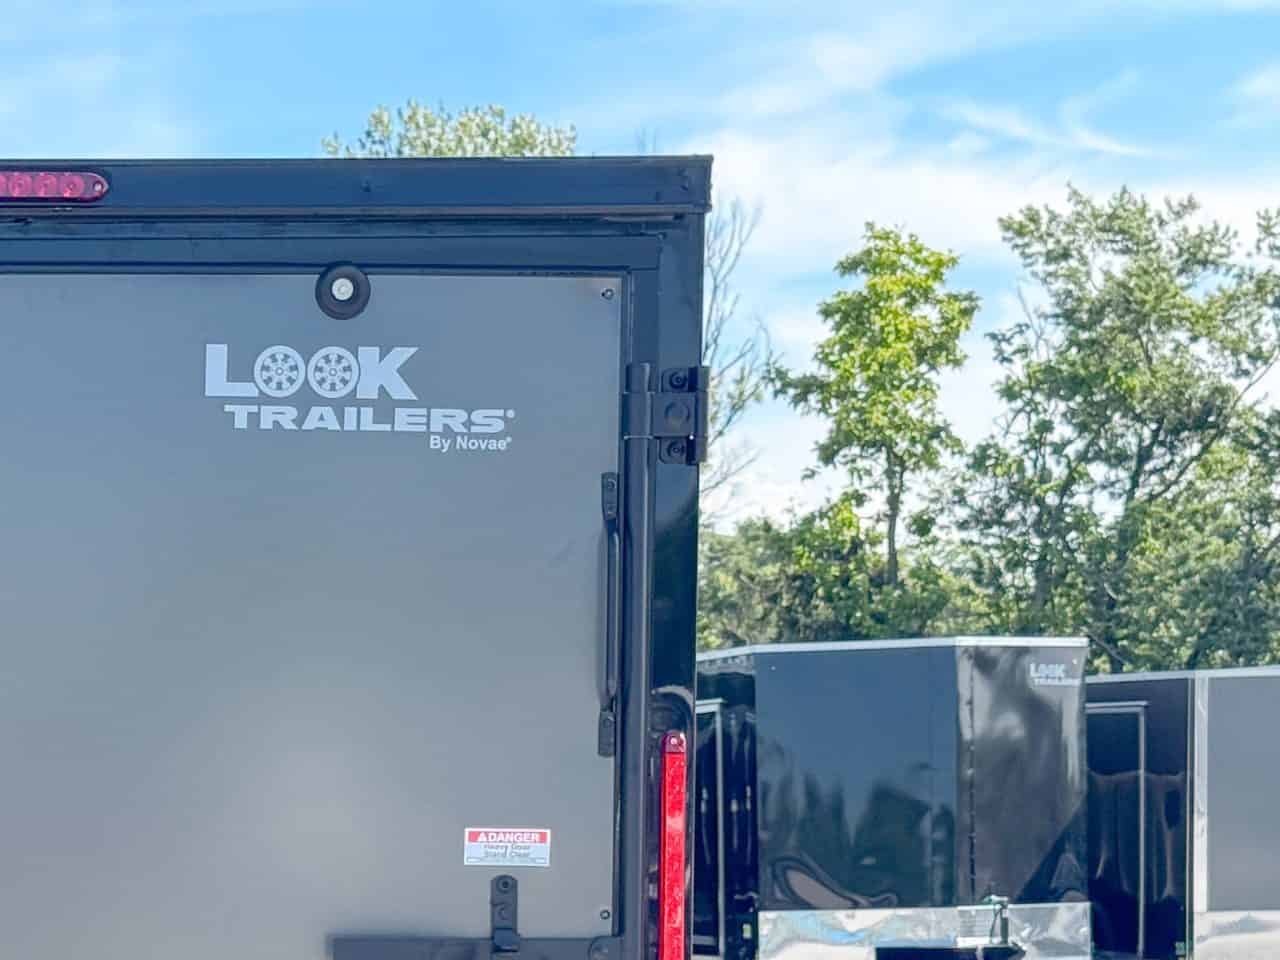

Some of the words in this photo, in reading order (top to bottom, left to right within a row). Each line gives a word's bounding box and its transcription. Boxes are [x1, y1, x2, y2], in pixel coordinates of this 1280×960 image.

[205, 344, 419, 400] LOOK
[224, 404, 505, 433] TRAILERS
[430, 434, 451, 453] By
[456, 435, 507, 450] Novae
[488, 832, 539, 842] DANGER
